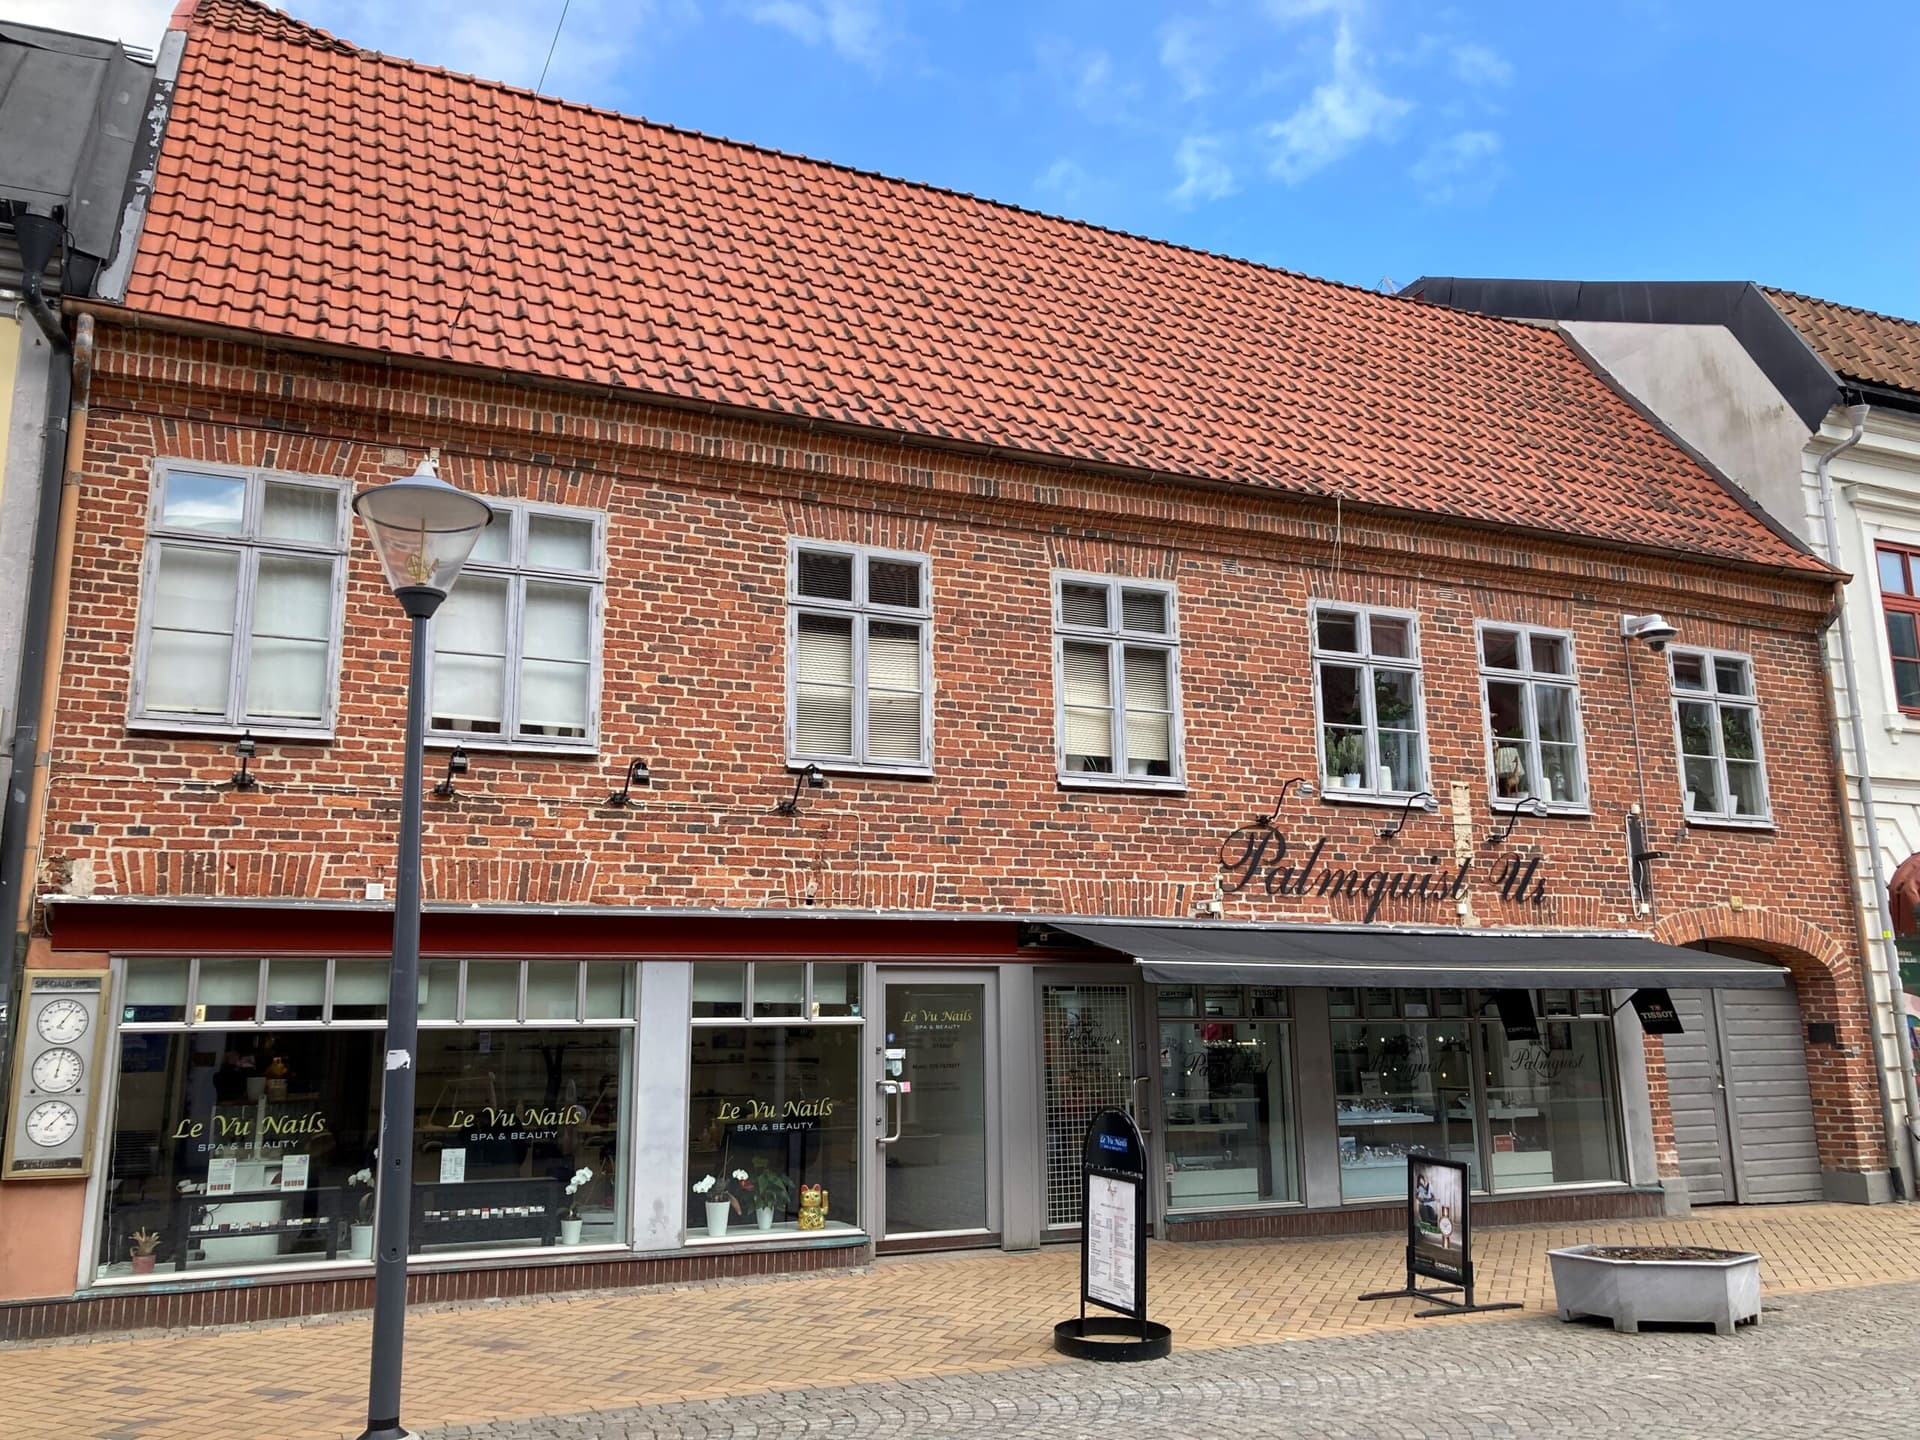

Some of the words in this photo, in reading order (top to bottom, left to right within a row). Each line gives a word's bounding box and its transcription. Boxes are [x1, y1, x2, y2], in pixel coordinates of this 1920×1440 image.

[1219, 825, 1471, 923] Palmquist
[1489, 852, 1548, 904] Ur
[902, 1011, 917, 1022] Le
[921, 1010, 938, 1021] Vu
[941, 1008, 972, 1021] Nails
[1640, 1010, 1674, 1020] TISSOT
[717, 1102, 741, 1120] Le
[746, 1099, 776, 1119] Vu
[781, 1097, 833, 1118] Nails
[448, 1110, 475, 1128] Le
[482, 1107, 516, 1127] Vu
[521, 1104, 582, 1126] Nails
[171, 1118, 203, 1138] Le
[212, 1114, 250, 1136] Vu
[258, 1111, 326, 1135] Nails
[737, 1124, 758, 1132] SPA
[761, 1123, 768, 1131] &
[772, 1122, 813, 1130] BEAUTY
[470, 1133, 494, 1141] SPA
[511, 1131, 558, 1140] BEAUTY
[197, 1143, 224, 1152] SPA
[230, 1142, 239, 1150] &
